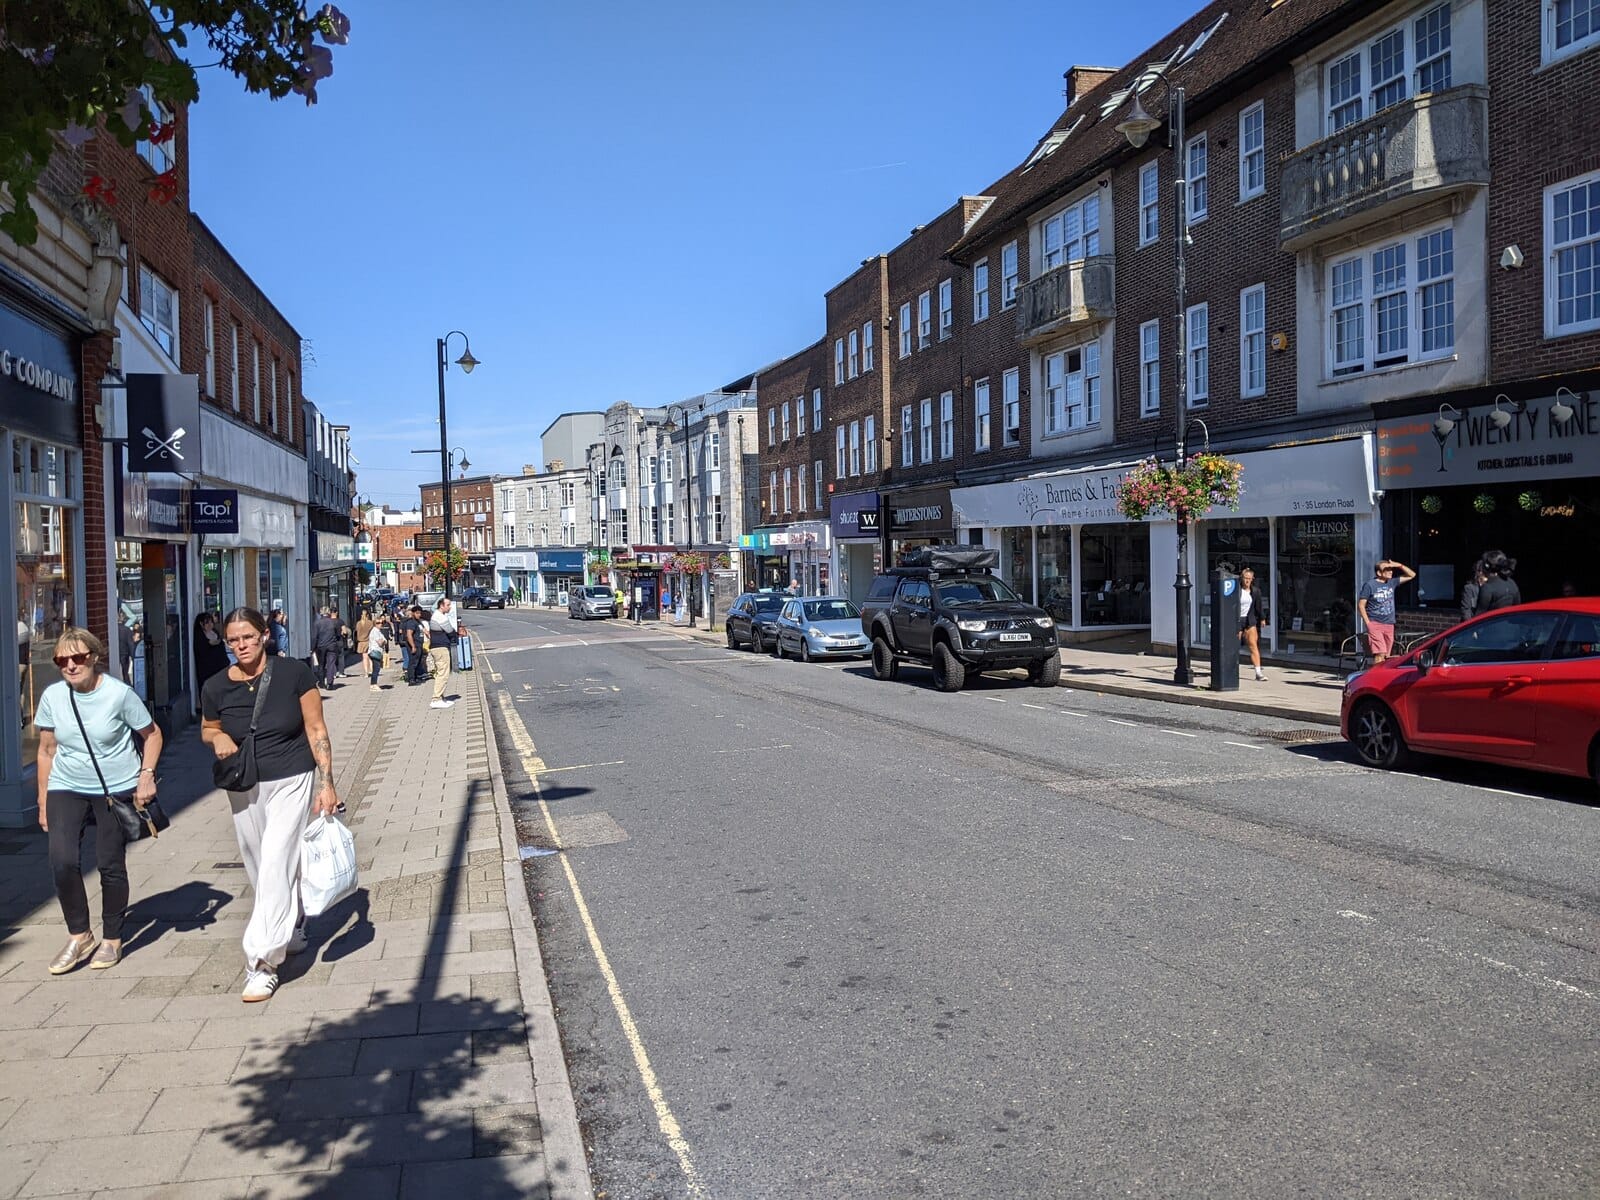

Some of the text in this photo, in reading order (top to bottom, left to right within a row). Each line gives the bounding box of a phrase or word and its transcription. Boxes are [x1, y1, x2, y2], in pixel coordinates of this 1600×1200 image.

[16, 357, 74, 402] COMPANY
[1559, 452, 1574, 464] BAR
[1045, 474, 1123, 504] Barnes & Fad
[194, 499, 231, 519] Tapi
[1306, 500, 1313, 509] 35
[1314, 500, 1337, 509] London
[1337, 499, 1354, 508] Road
[862, 514, 877, 525] W
[896, 505, 942, 523] WATERSTONES
[1061, 507, 1119, 519] Home Furnishi
[1307, 520, 1349, 533] HYPNOS
[1224, 580, 1232, 593] P
